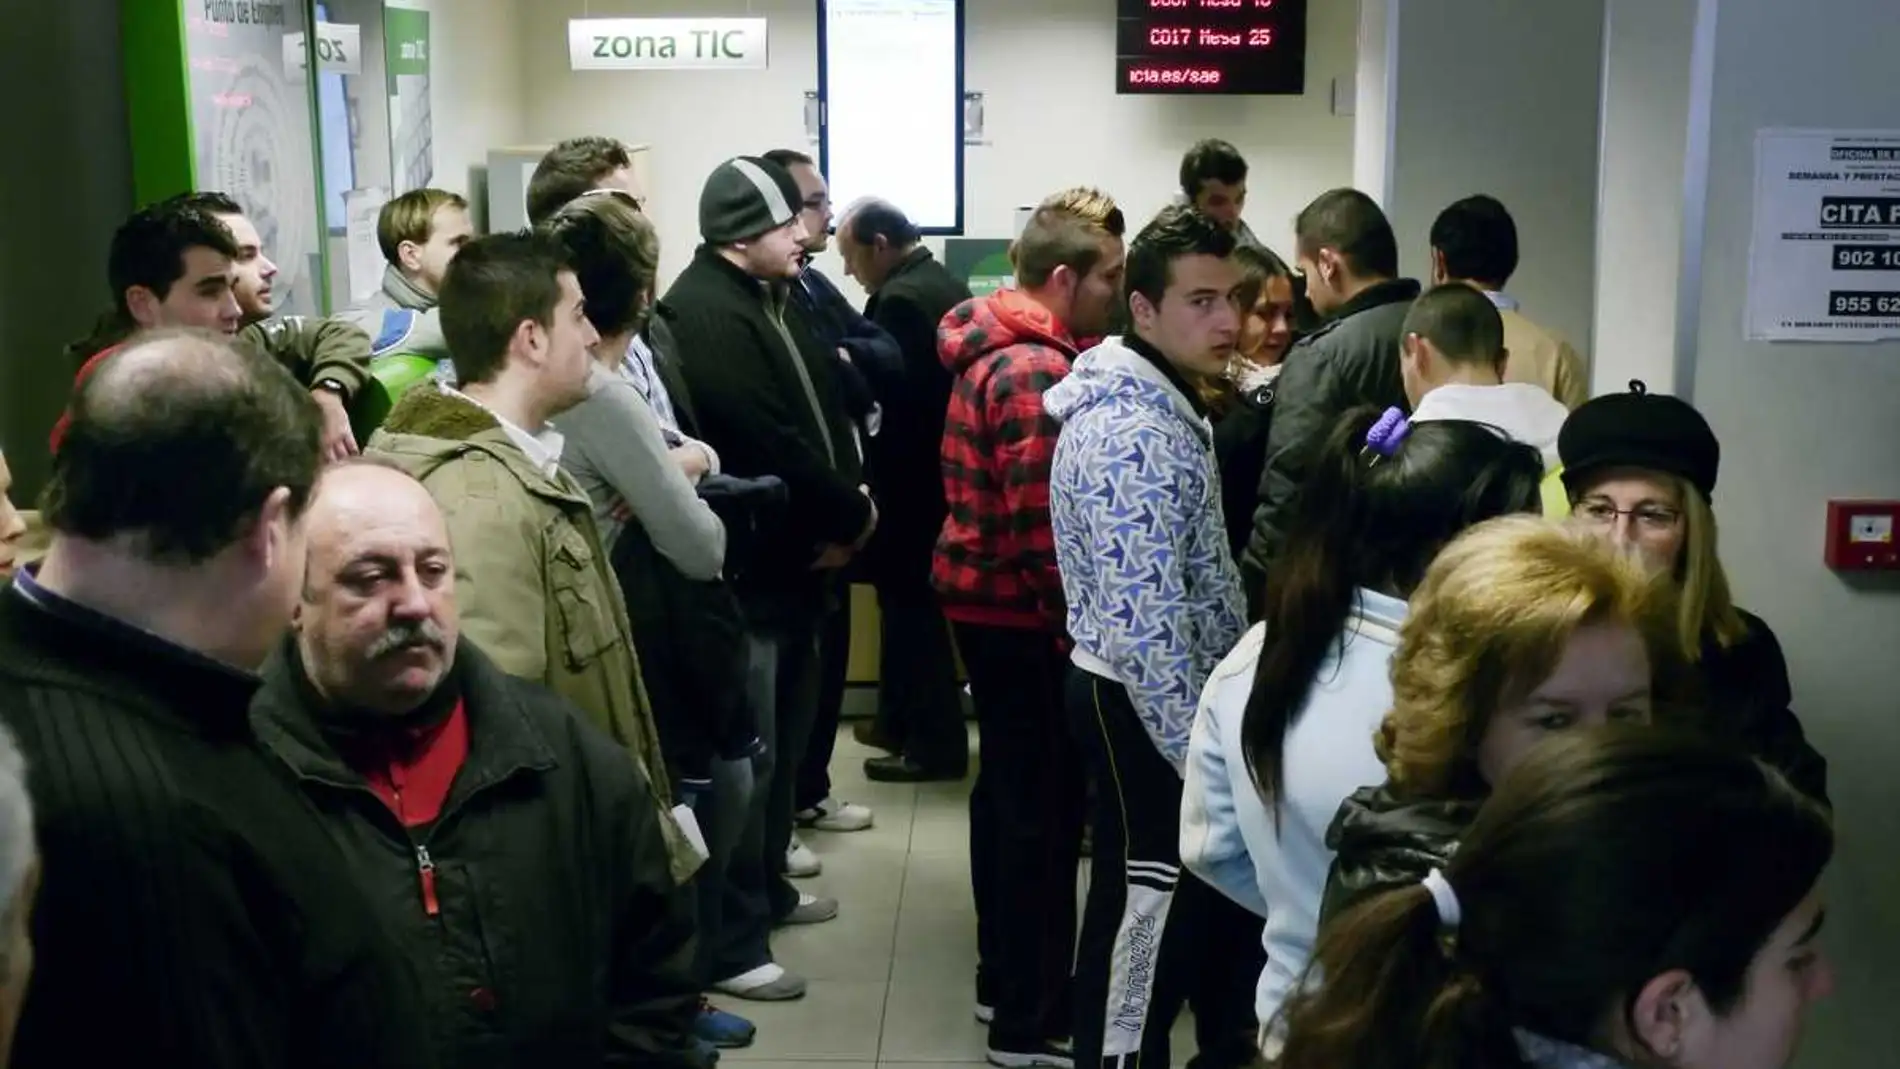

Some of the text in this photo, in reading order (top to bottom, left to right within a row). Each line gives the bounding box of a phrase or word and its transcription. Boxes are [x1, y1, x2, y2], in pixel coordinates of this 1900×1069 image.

[592, 29, 745, 58] zona TIC
[1200, 29, 1241, 45] Mesa
[1248, 29, 1271, 45] 25
[1822, 204, 1882, 223] CITA
[1838, 250, 1875, 266] 902
[1835, 296, 1900, 313] 955 62
